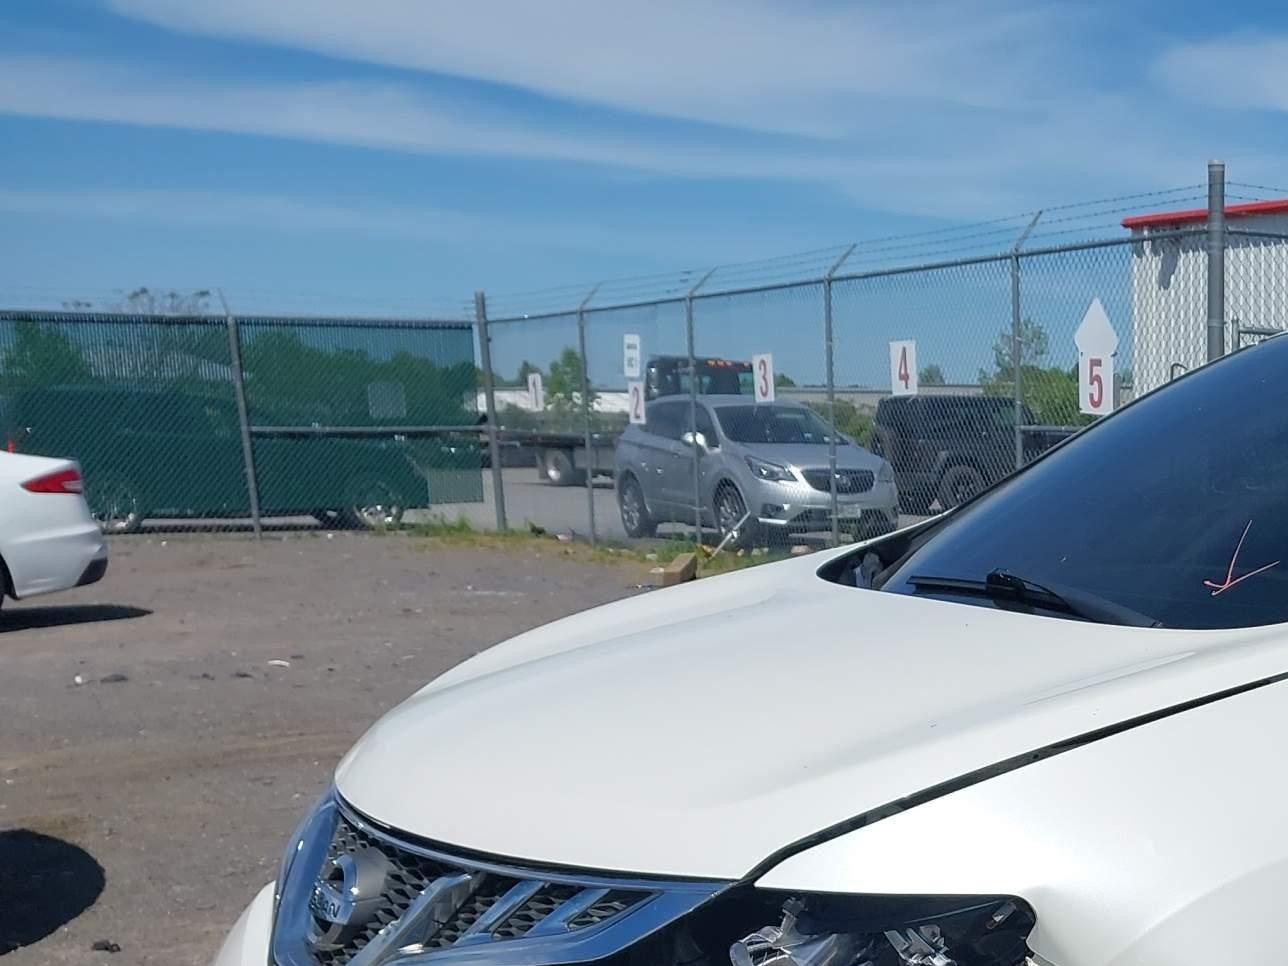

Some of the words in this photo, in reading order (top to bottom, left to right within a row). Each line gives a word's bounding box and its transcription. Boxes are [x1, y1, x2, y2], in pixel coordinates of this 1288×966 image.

[758, 359, 769, 397] 3
[898, 346, 909, 390] 4
[1088, 358, 1103, 408] 5
[632, 386, 641, 419] 2
